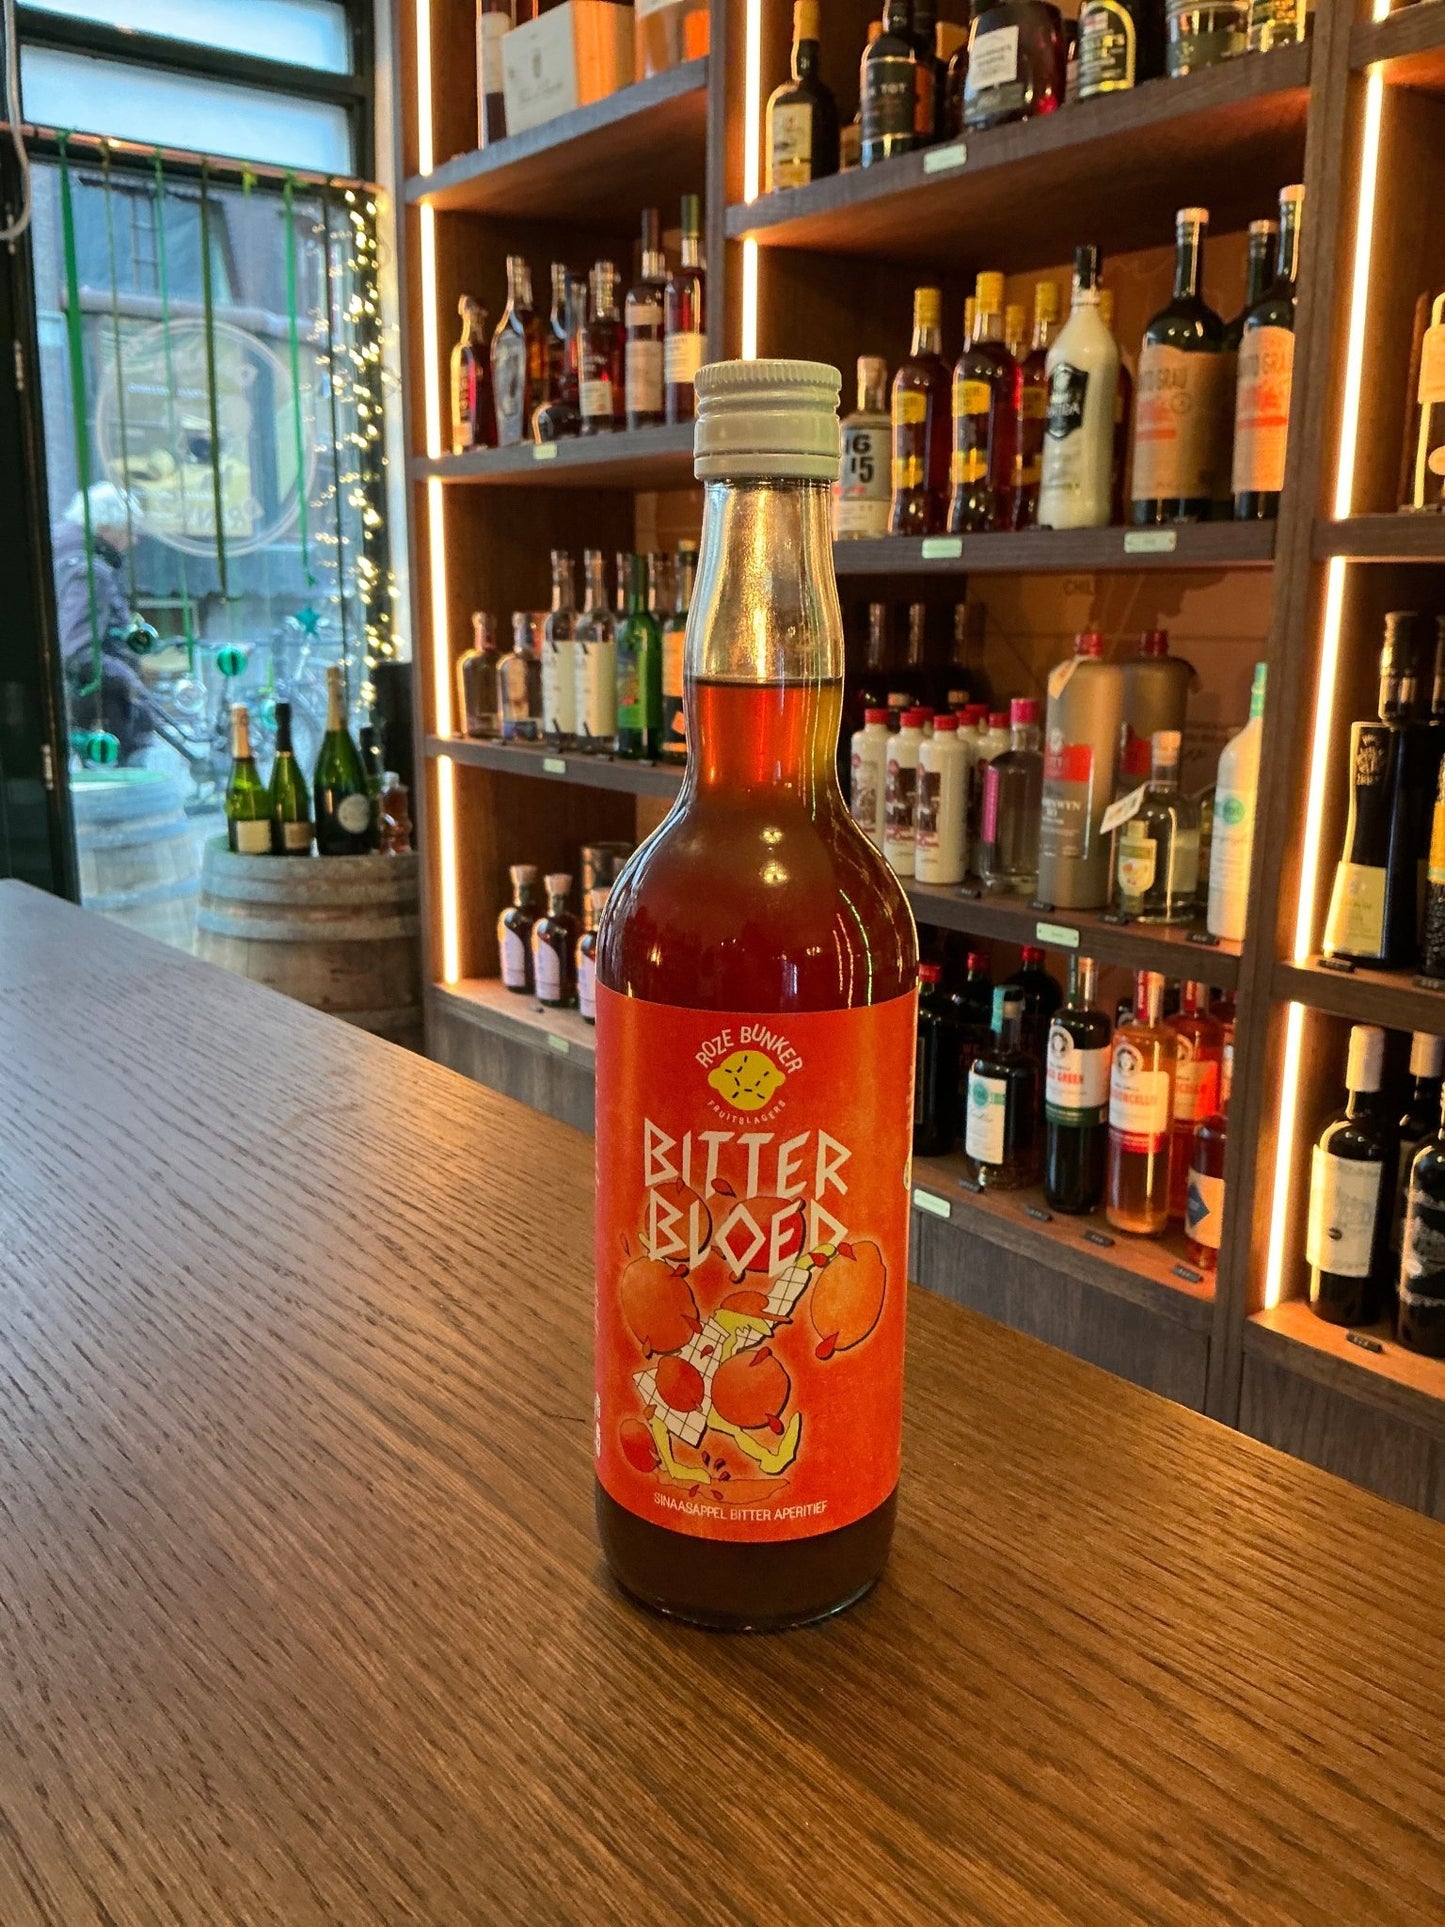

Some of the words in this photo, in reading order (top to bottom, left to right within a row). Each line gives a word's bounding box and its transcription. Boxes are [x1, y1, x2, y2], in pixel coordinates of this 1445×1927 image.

[850, 456, 875, 484] 15
[695, 1029, 735, 1069] ROZE
[740, 1023, 803, 1075] BUNKER
[707, 1100, 787, 1125] FRUITSLAGERS
[644, 1117, 852, 1200] BITTER
[649, 1188, 849, 1278] BLOED
[653, 1492, 728, 1520] SINAASAPPEL
[730, 1508, 771, 1521] BITTER
[774, 1499, 828, 1520] APERITIEF
